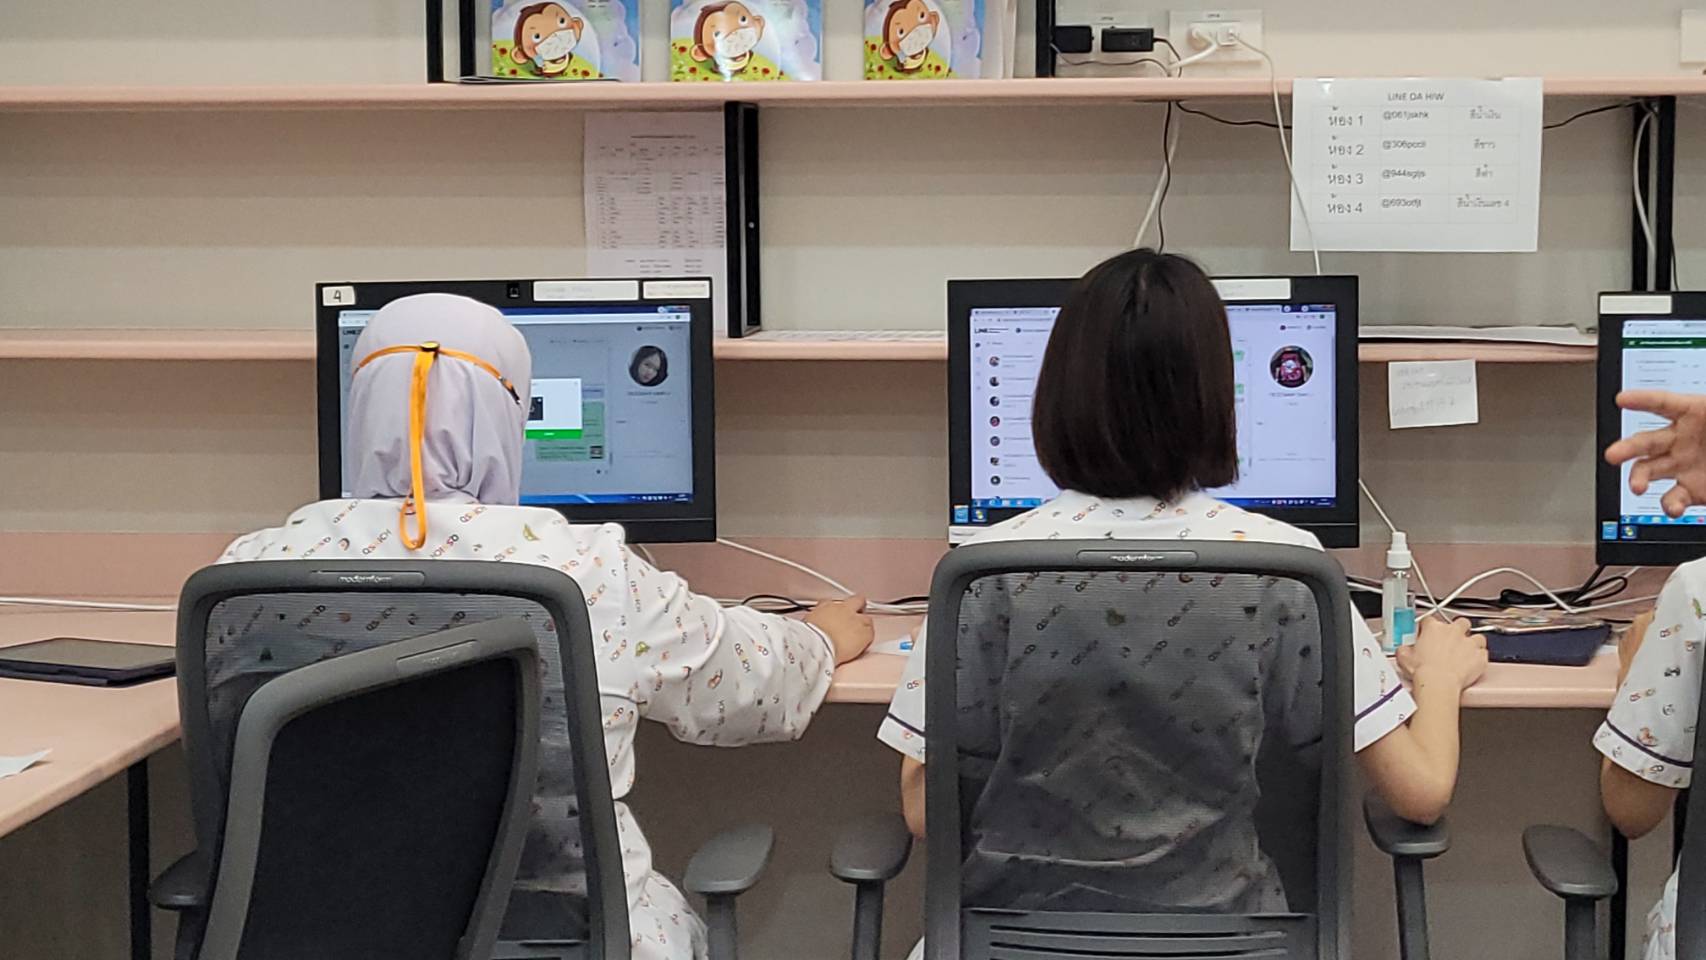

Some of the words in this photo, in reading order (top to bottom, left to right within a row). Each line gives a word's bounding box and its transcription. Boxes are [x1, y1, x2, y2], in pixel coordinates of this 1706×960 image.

[1388, 92, 1407, 101] LINE
[1358, 115, 1363, 126] 1
[1355, 144, 1364, 155] 2
[1355, 172, 1364, 184] 3
[1354, 202, 1363, 213] 4
[333, 289, 342, 303] 4
